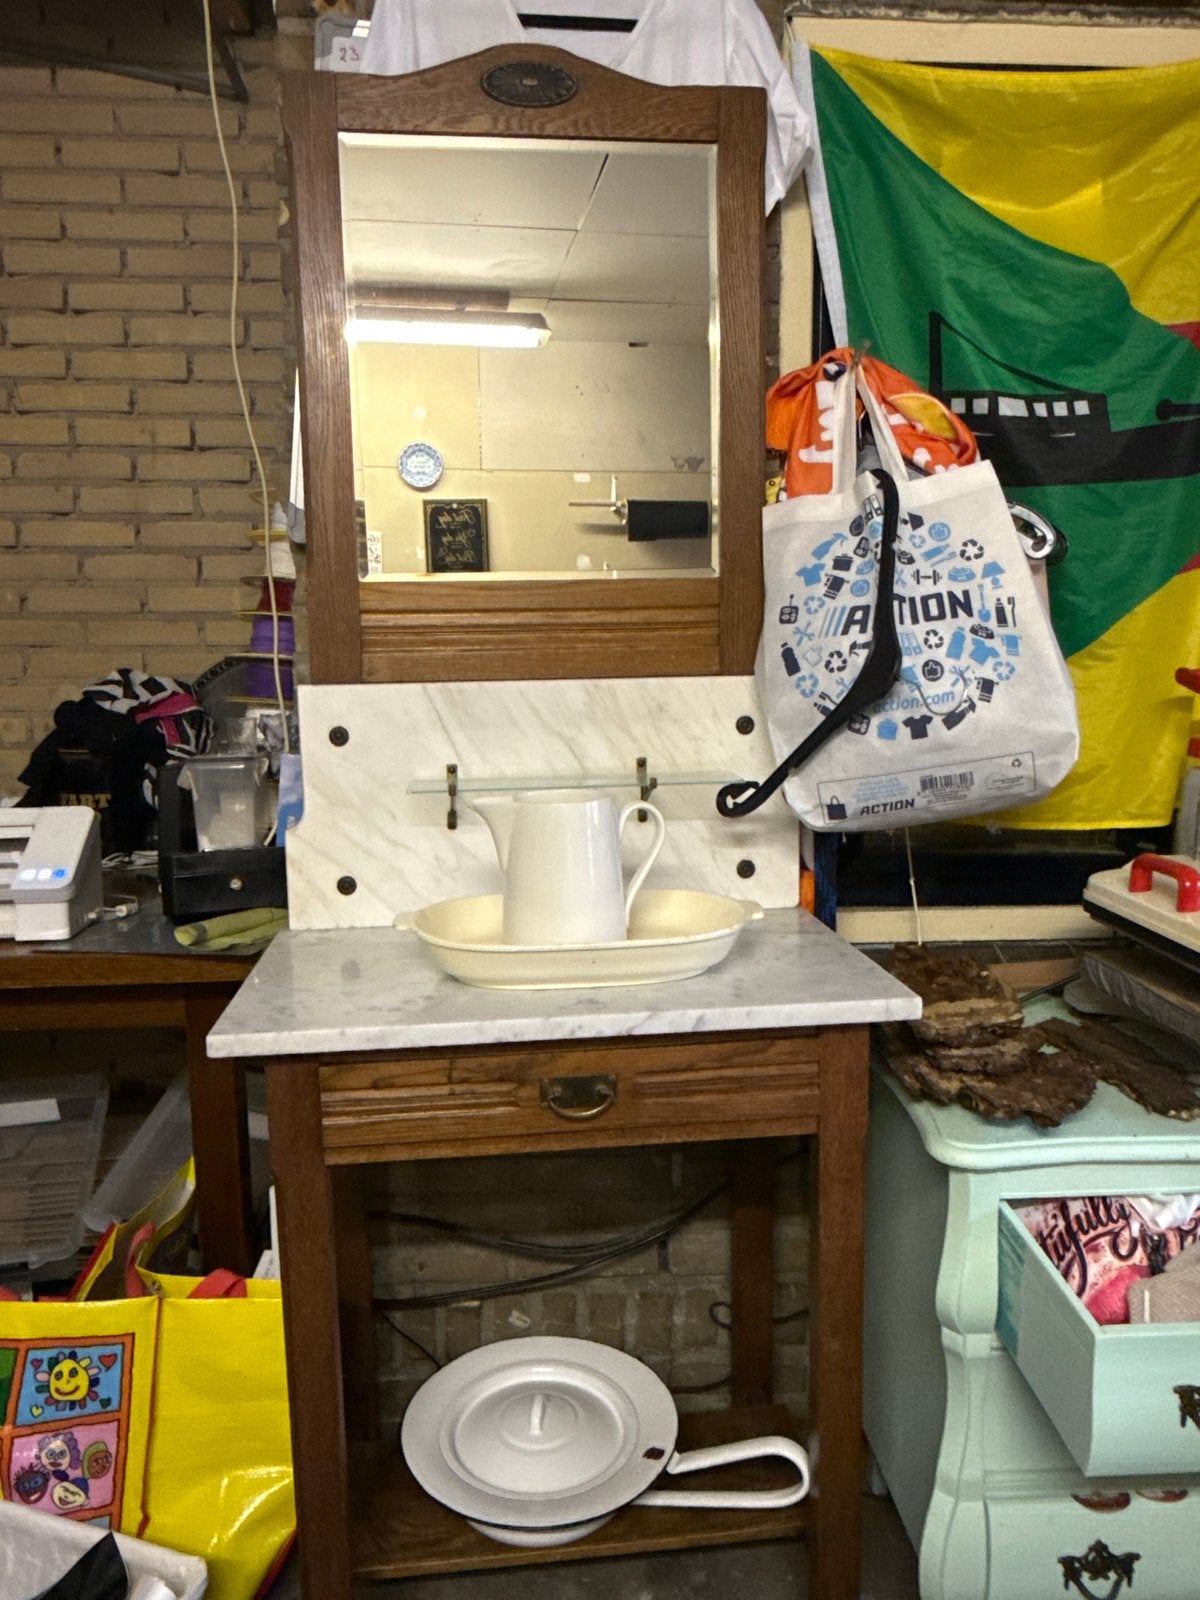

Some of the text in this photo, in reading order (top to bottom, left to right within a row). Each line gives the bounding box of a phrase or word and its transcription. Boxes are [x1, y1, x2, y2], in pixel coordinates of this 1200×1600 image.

[339, 46, 360, 62] 23
[841, 589, 974, 636] ATION
[860, 798, 916, 816] ACTION
